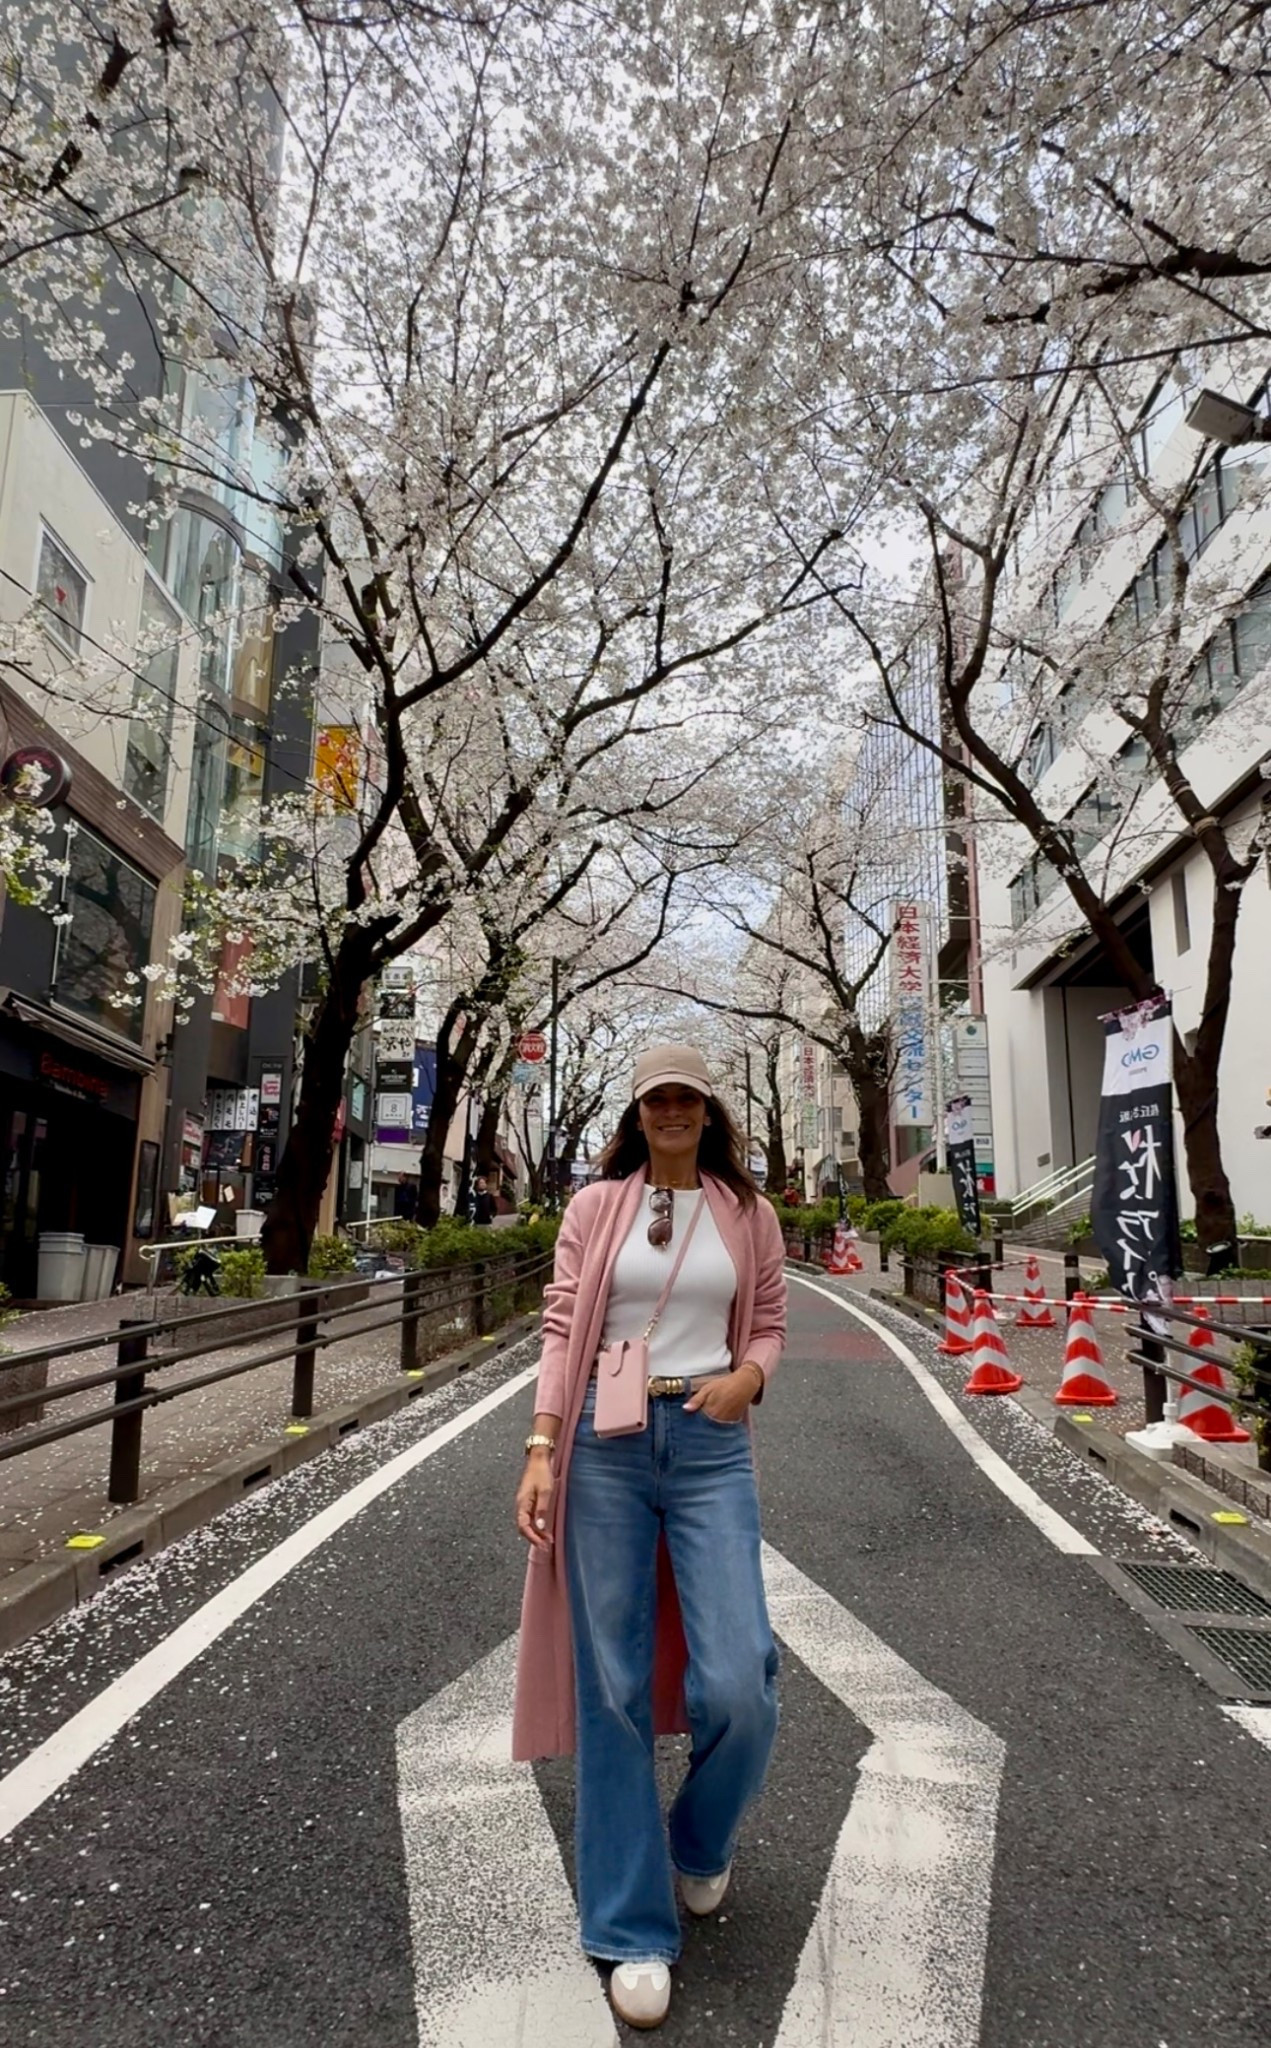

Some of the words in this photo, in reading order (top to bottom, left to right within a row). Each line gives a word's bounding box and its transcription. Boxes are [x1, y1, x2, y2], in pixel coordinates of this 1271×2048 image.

[896, 906, 922, 993] 日本経済大学
